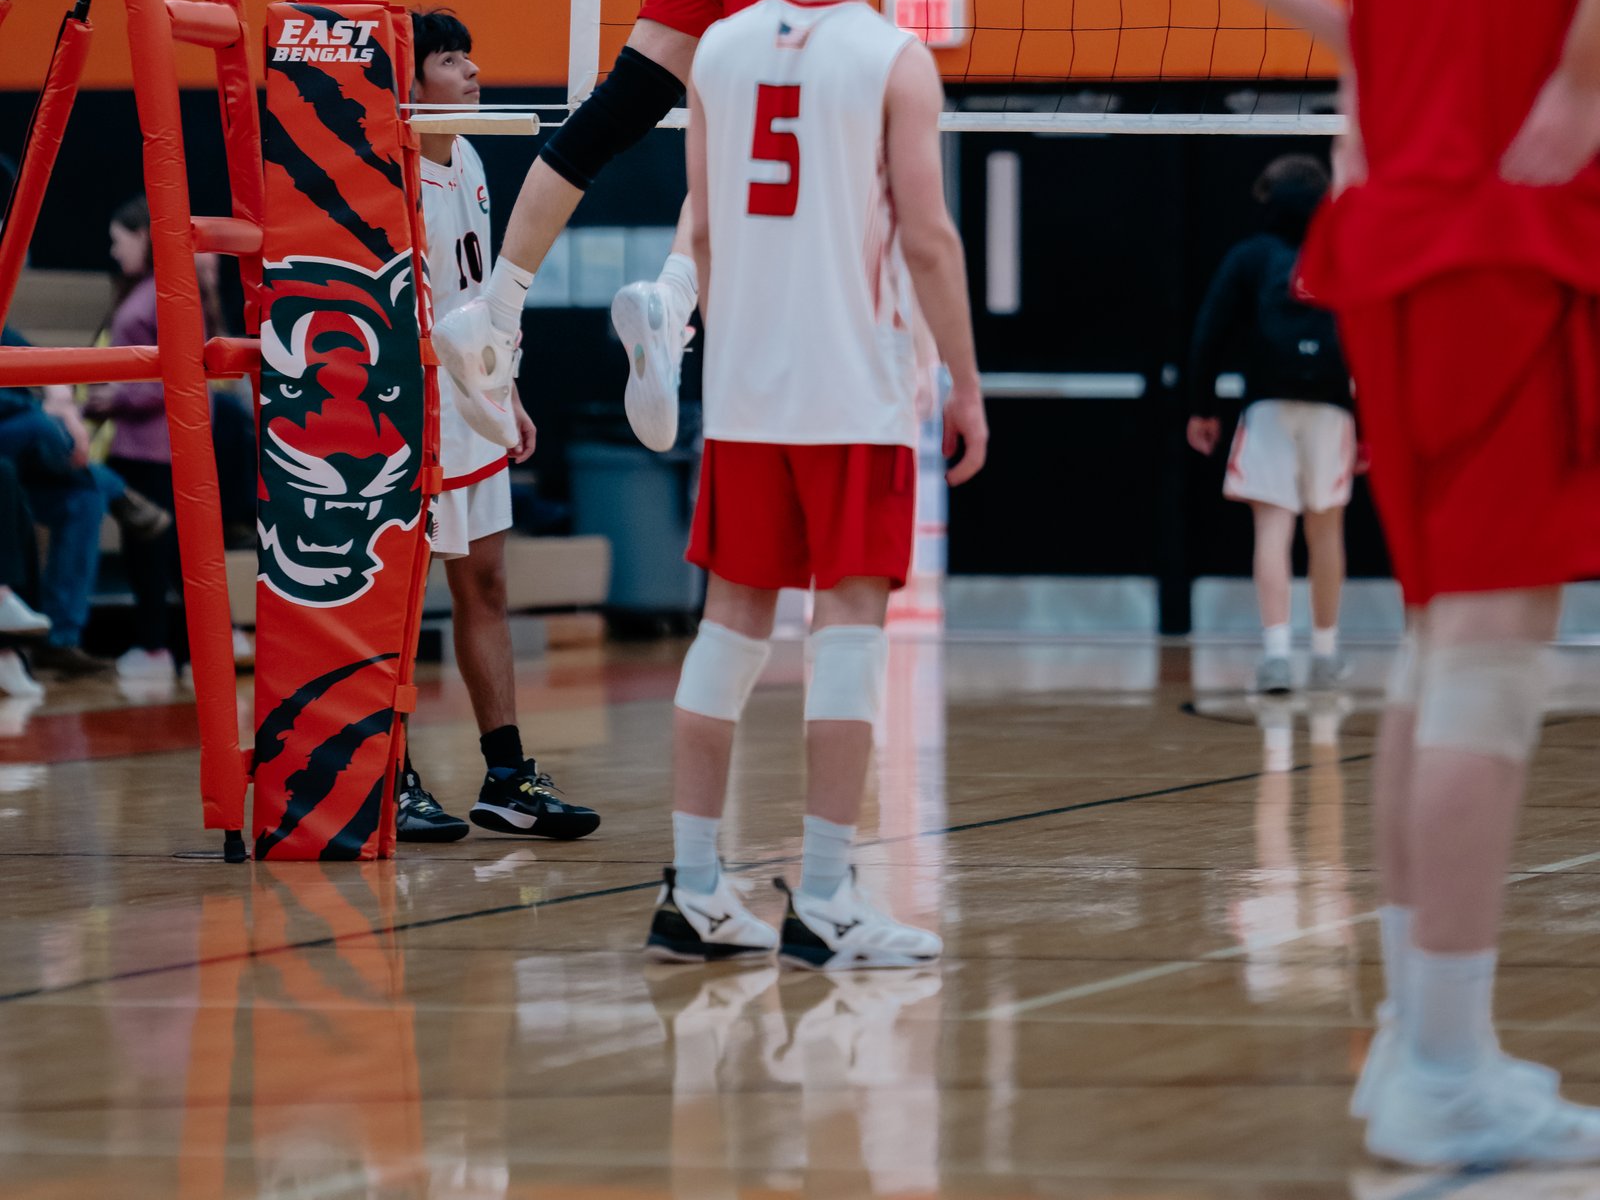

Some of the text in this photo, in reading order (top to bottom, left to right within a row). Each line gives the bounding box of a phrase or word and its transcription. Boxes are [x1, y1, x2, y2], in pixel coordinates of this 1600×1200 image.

[277, 19, 379, 46] EAST
[272, 47, 374, 62] BENGALS
[747, 84, 800, 216] 5
[455, 231, 483, 291] 10
